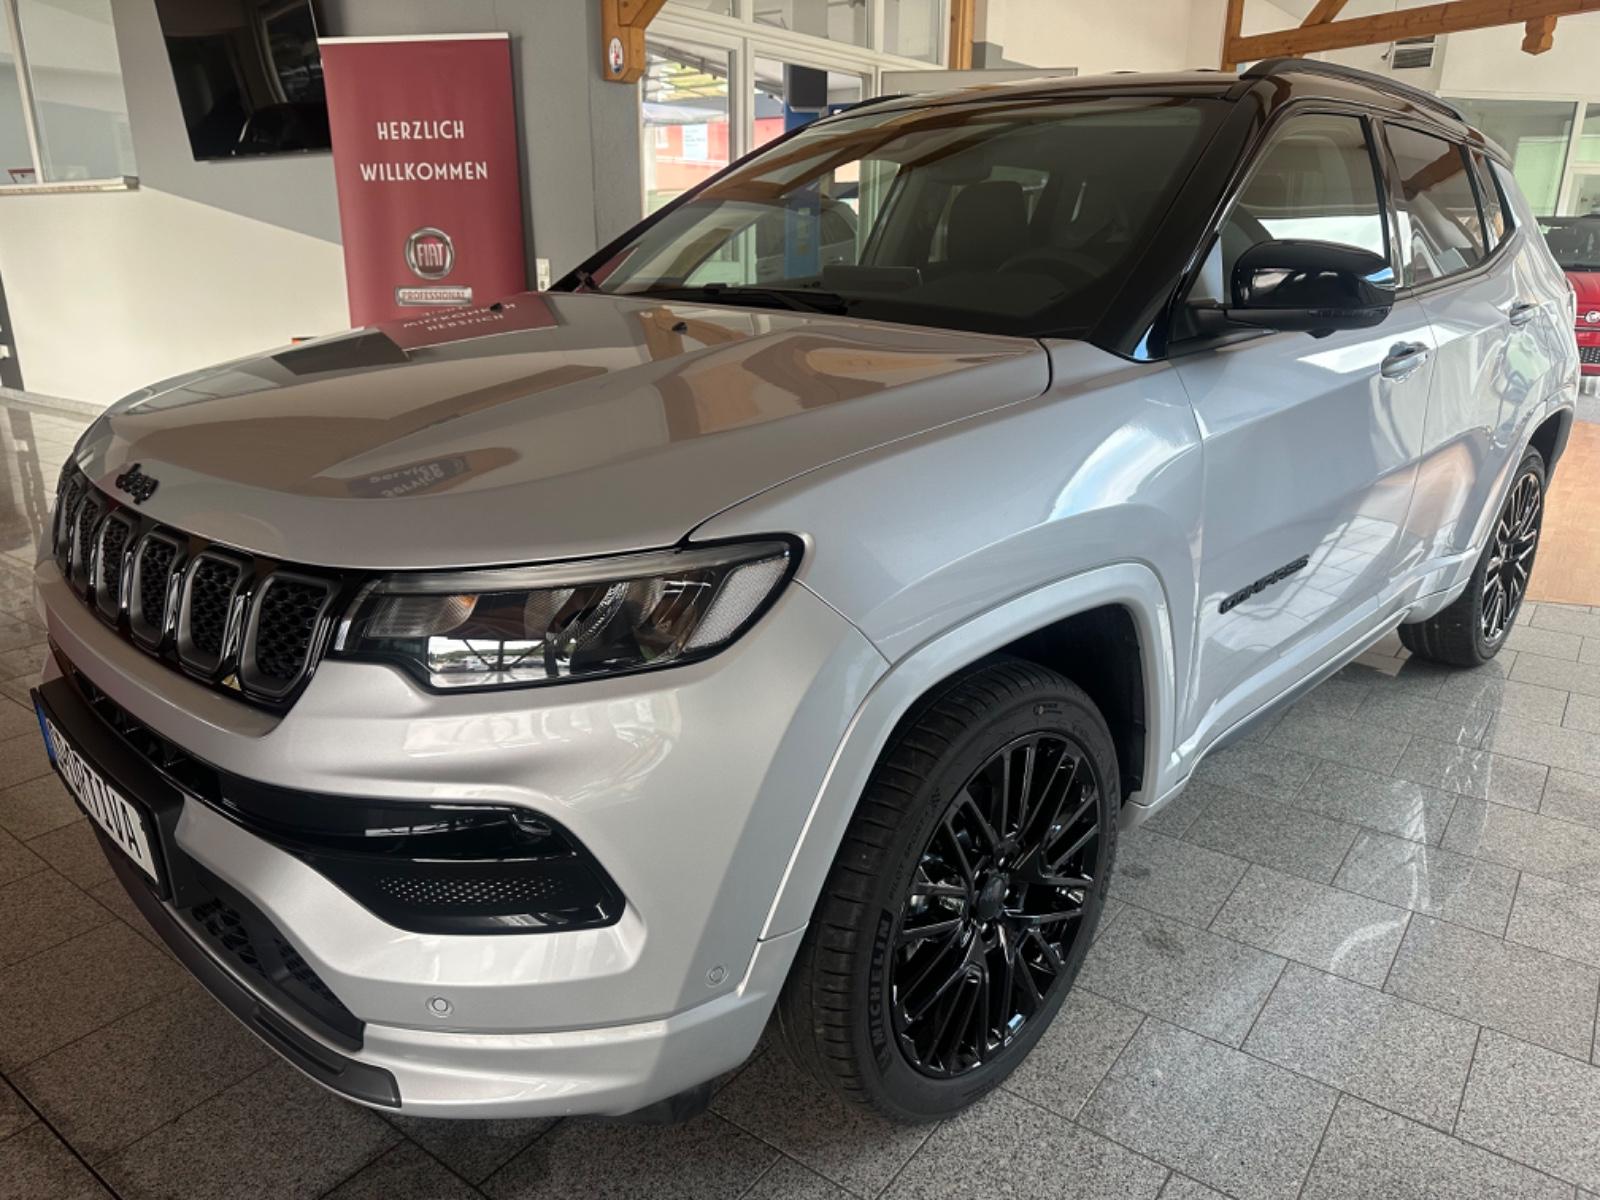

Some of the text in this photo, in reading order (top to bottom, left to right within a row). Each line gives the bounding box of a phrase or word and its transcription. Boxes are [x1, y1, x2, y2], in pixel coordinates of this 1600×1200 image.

[377, 120, 465, 140] HERZLICH
[360, 161, 488, 181] WILLKOMMEN
[416, 243, 443, 266] FIAT
[870, 919, 890, 1043] MICHELIN
